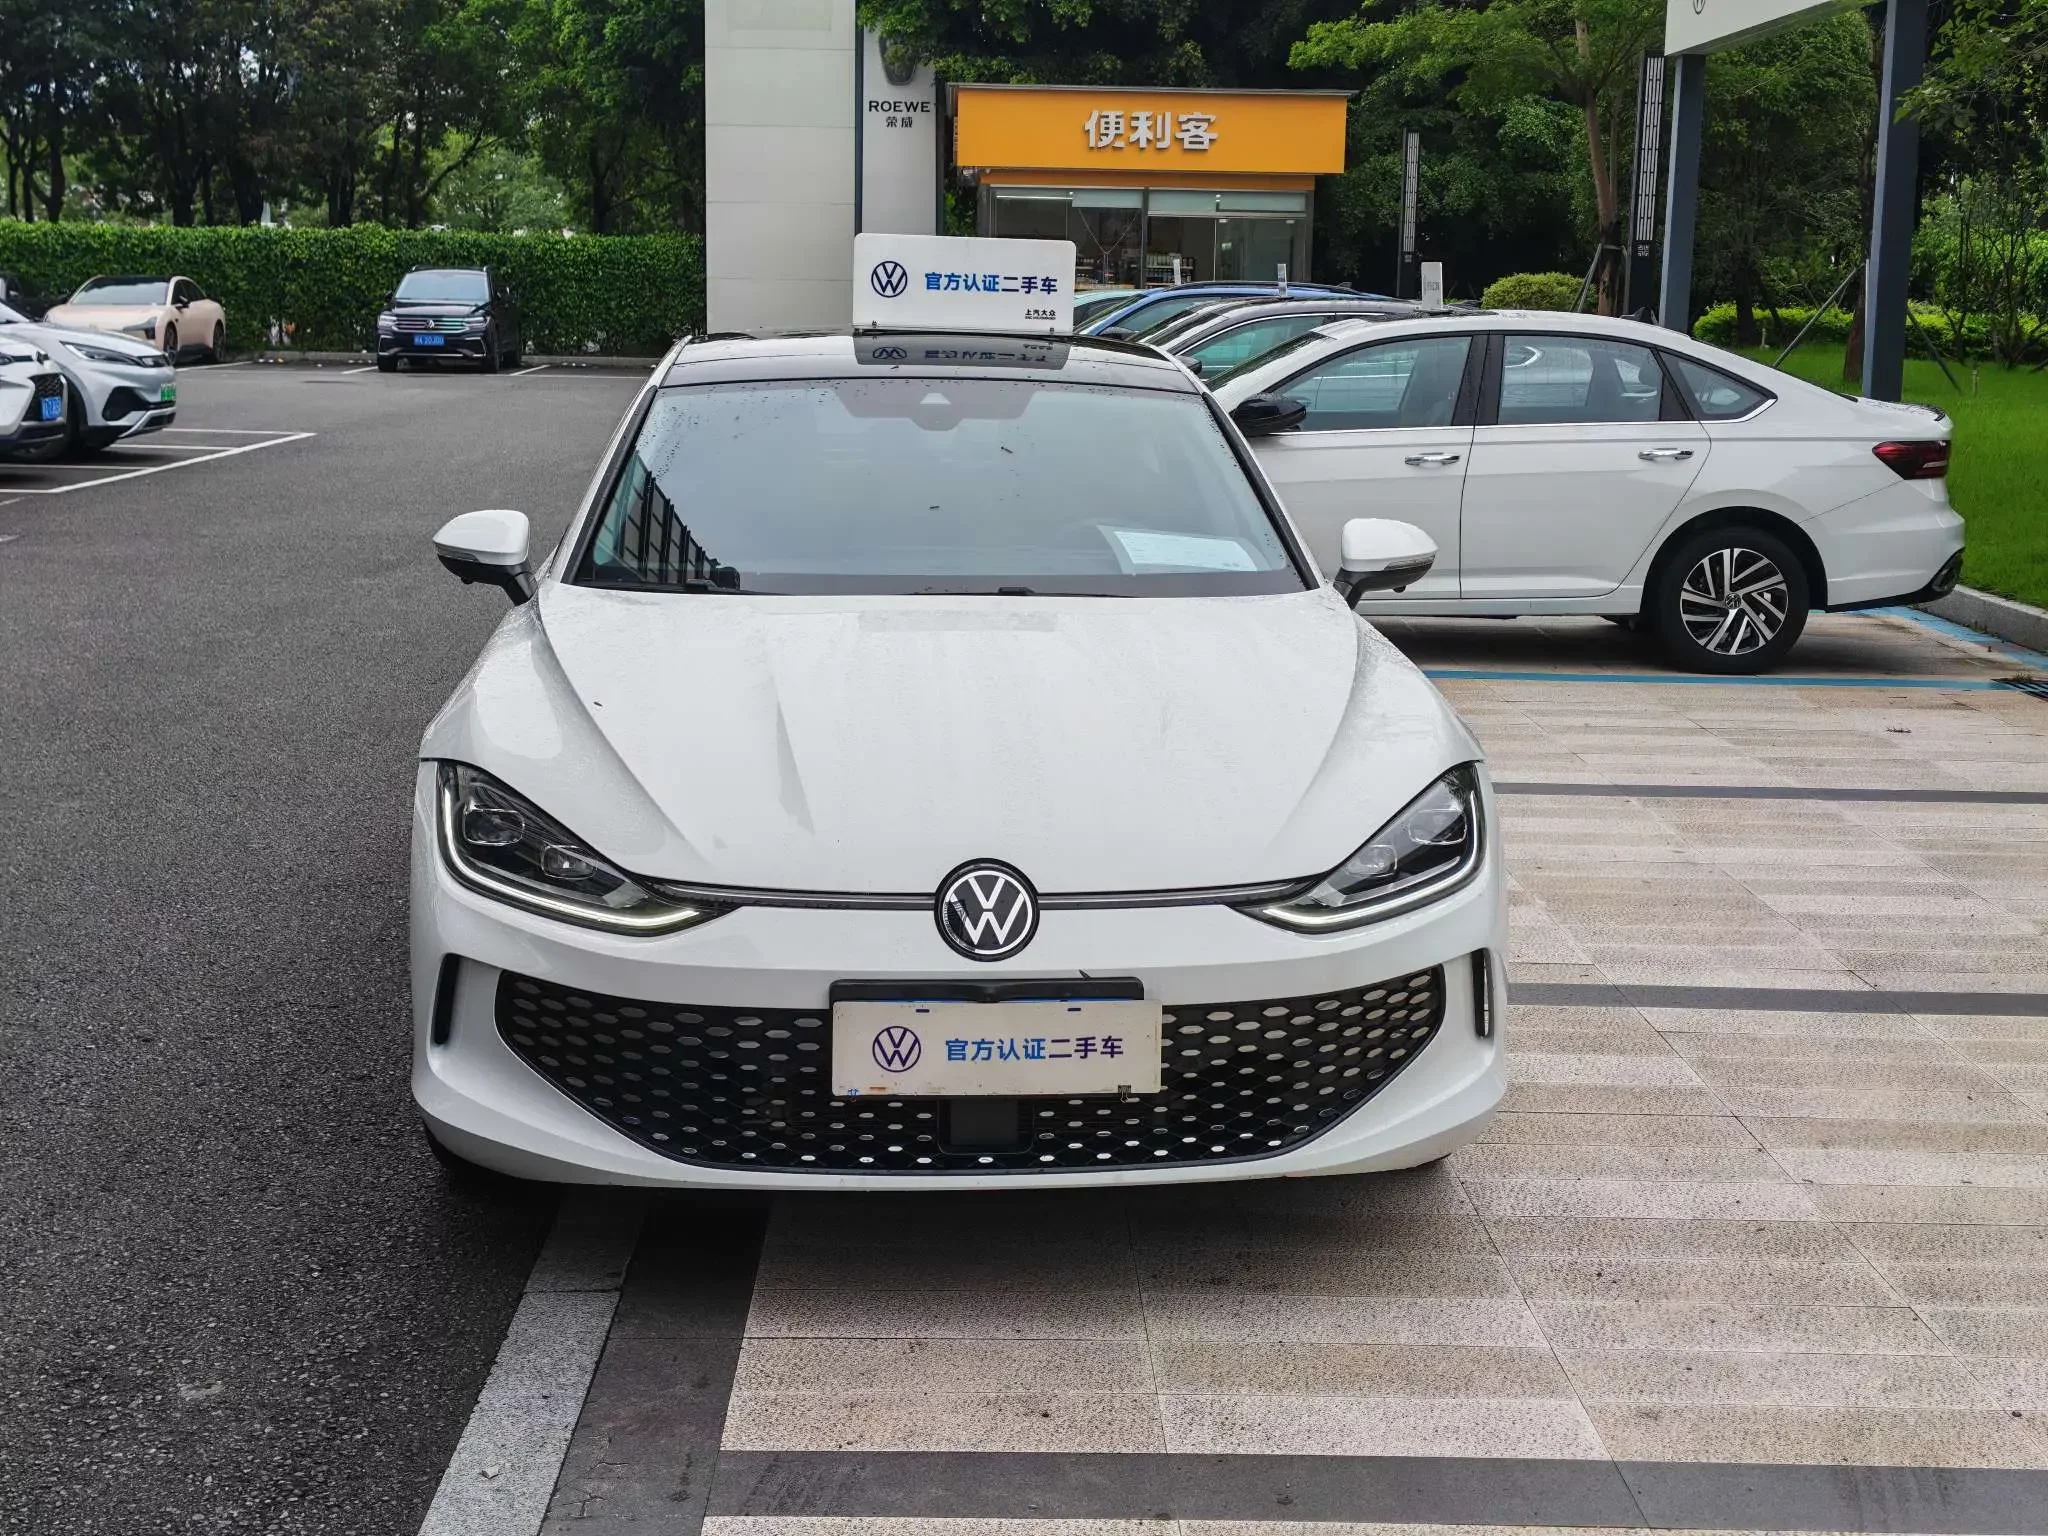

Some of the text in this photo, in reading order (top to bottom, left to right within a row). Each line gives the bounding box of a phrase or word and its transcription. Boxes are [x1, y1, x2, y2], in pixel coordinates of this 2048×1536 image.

[868, 101, 931, 113] ROEWE
[886, 116, 913, 128] 荣威
[1084, 110, 1219, 151] 便利客
[924, 272, 1058, 295] 官方认证二手车
[1025, 308, 1056, 316] 上汽大众
[945, 1035, 1124, 1062] 官方认证二手车
